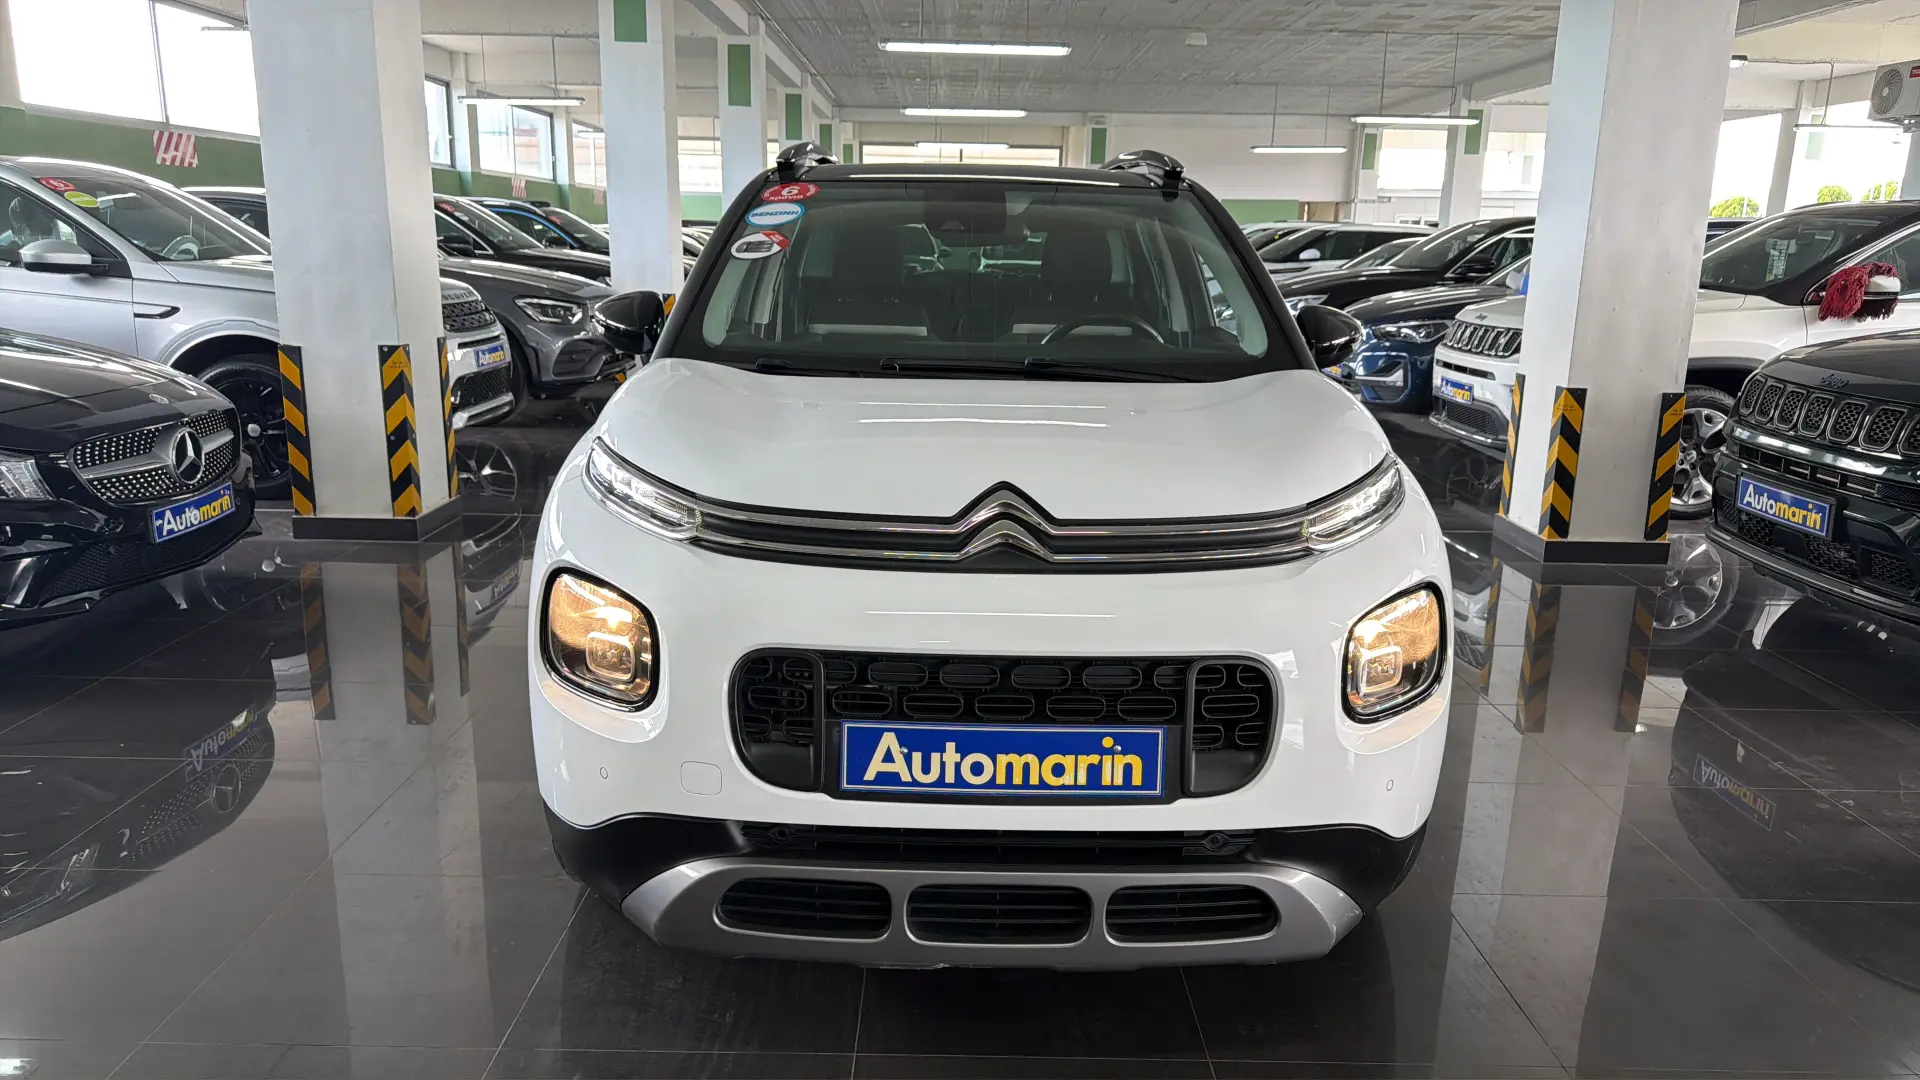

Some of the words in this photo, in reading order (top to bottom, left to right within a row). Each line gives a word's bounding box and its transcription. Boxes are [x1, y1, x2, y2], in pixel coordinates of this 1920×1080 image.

[781, 185, 800, 196] 6
[479, 346, 505, 366] Automarin
[1441, 379, 1471, 401] Automarin
[162, 489, 232, 536] Automarin
[1743, 483, 1822, 530] Automarin
[863, 731, 1143, 786] Automarin
